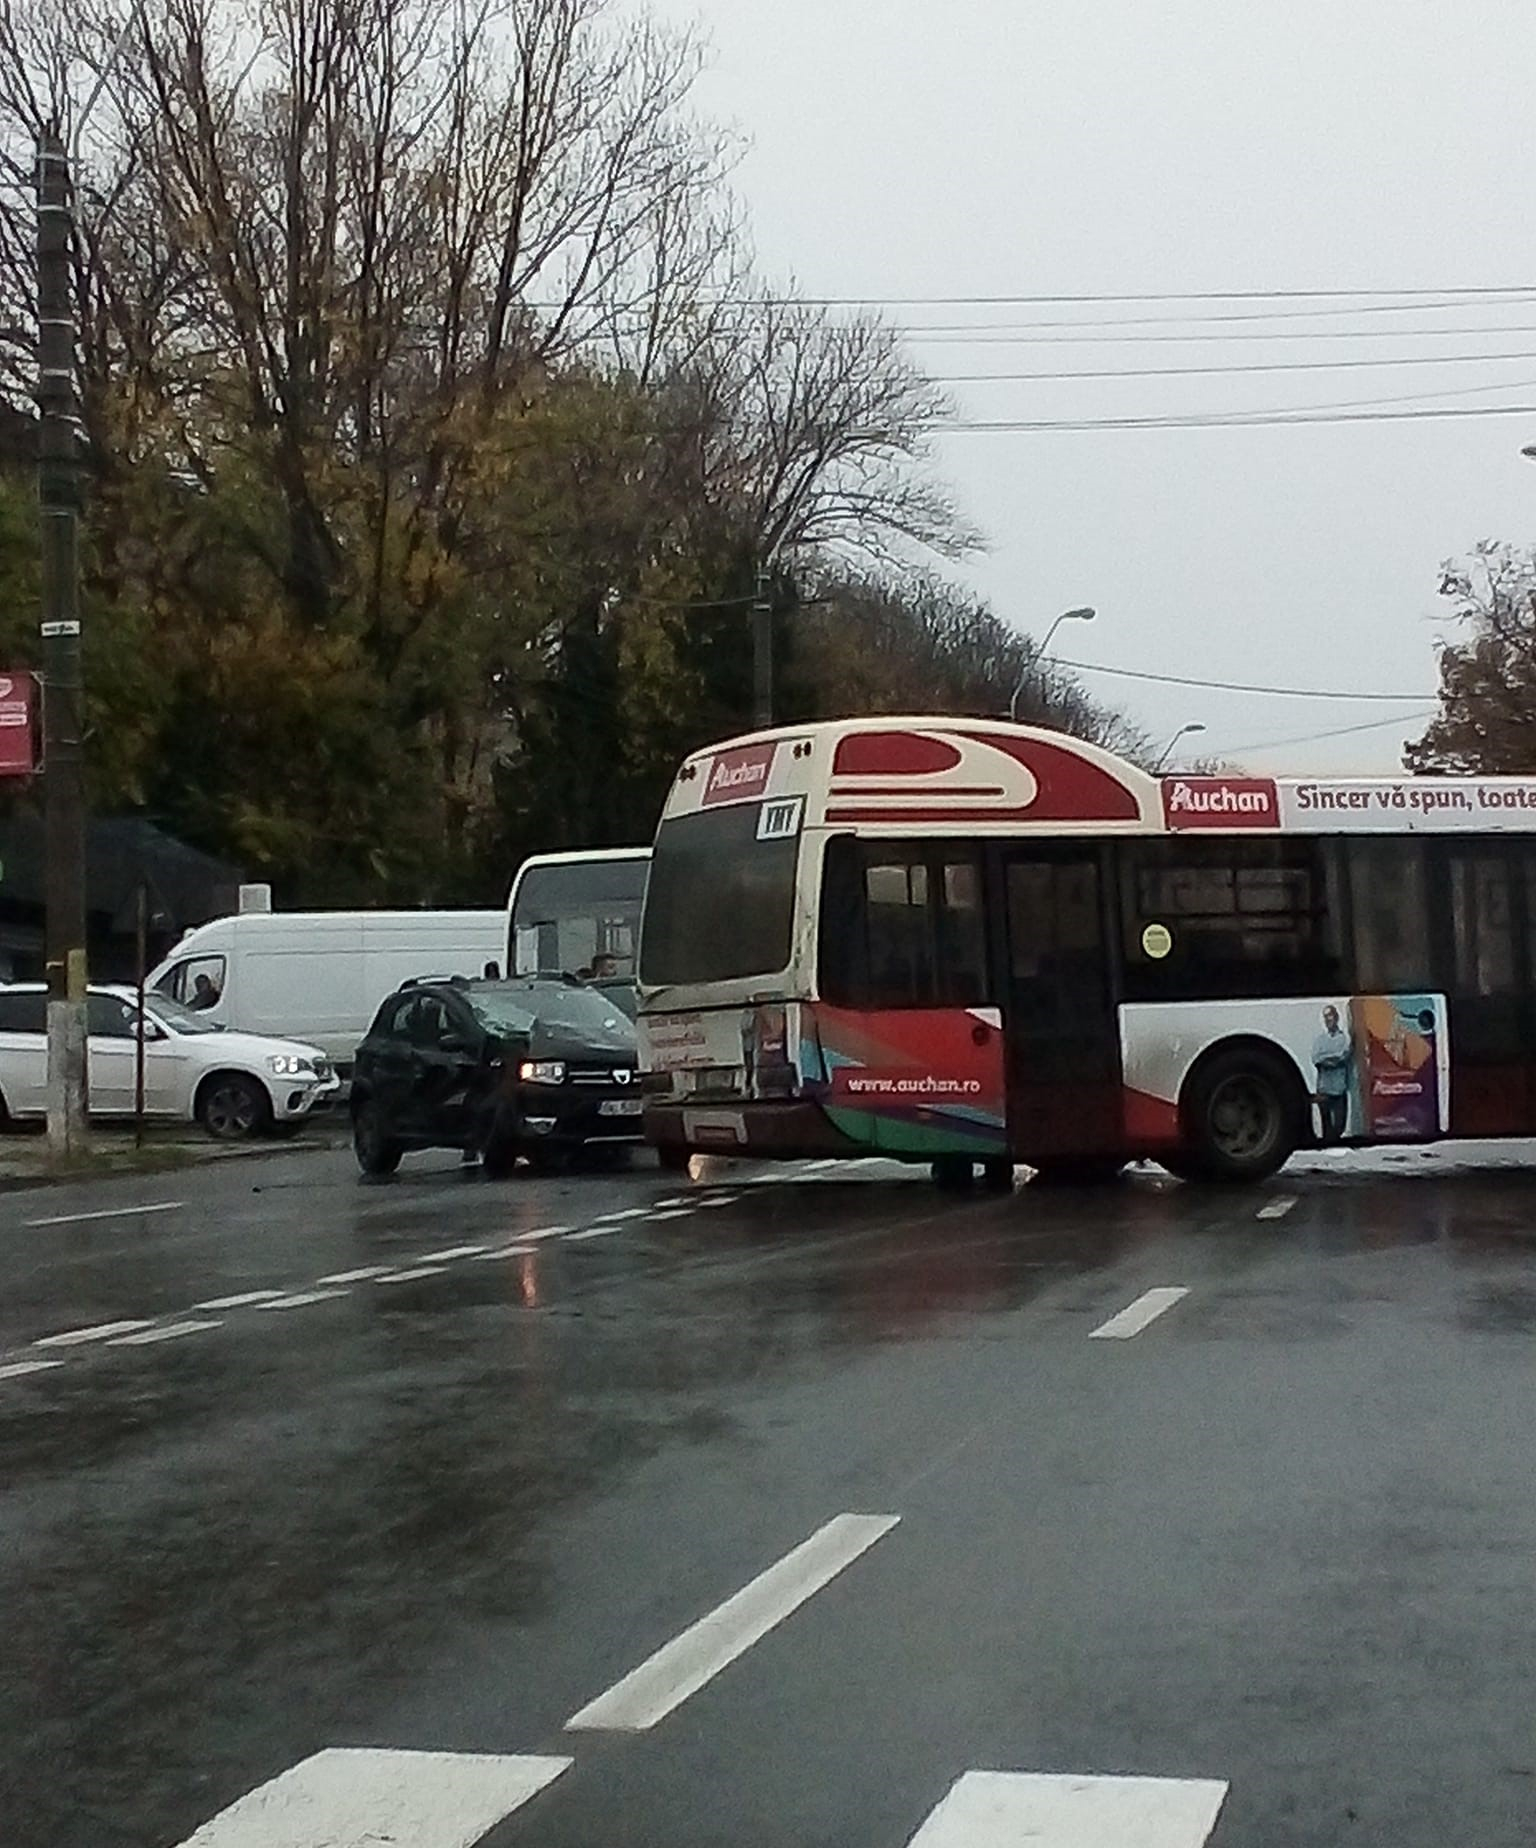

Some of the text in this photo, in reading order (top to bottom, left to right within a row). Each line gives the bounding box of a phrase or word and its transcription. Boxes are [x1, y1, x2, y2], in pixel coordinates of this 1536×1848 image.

[710, 762, 767, 791] Auchan
[1170, 783, 1268, 812] Auchan
[1297, 785, 1370, 809] Sincer
[1376, 786, 1406, 809] vă
[1410, 791, 1473, 815] spun,
[848, 1076, 980, 1093] www.auchan.ro
